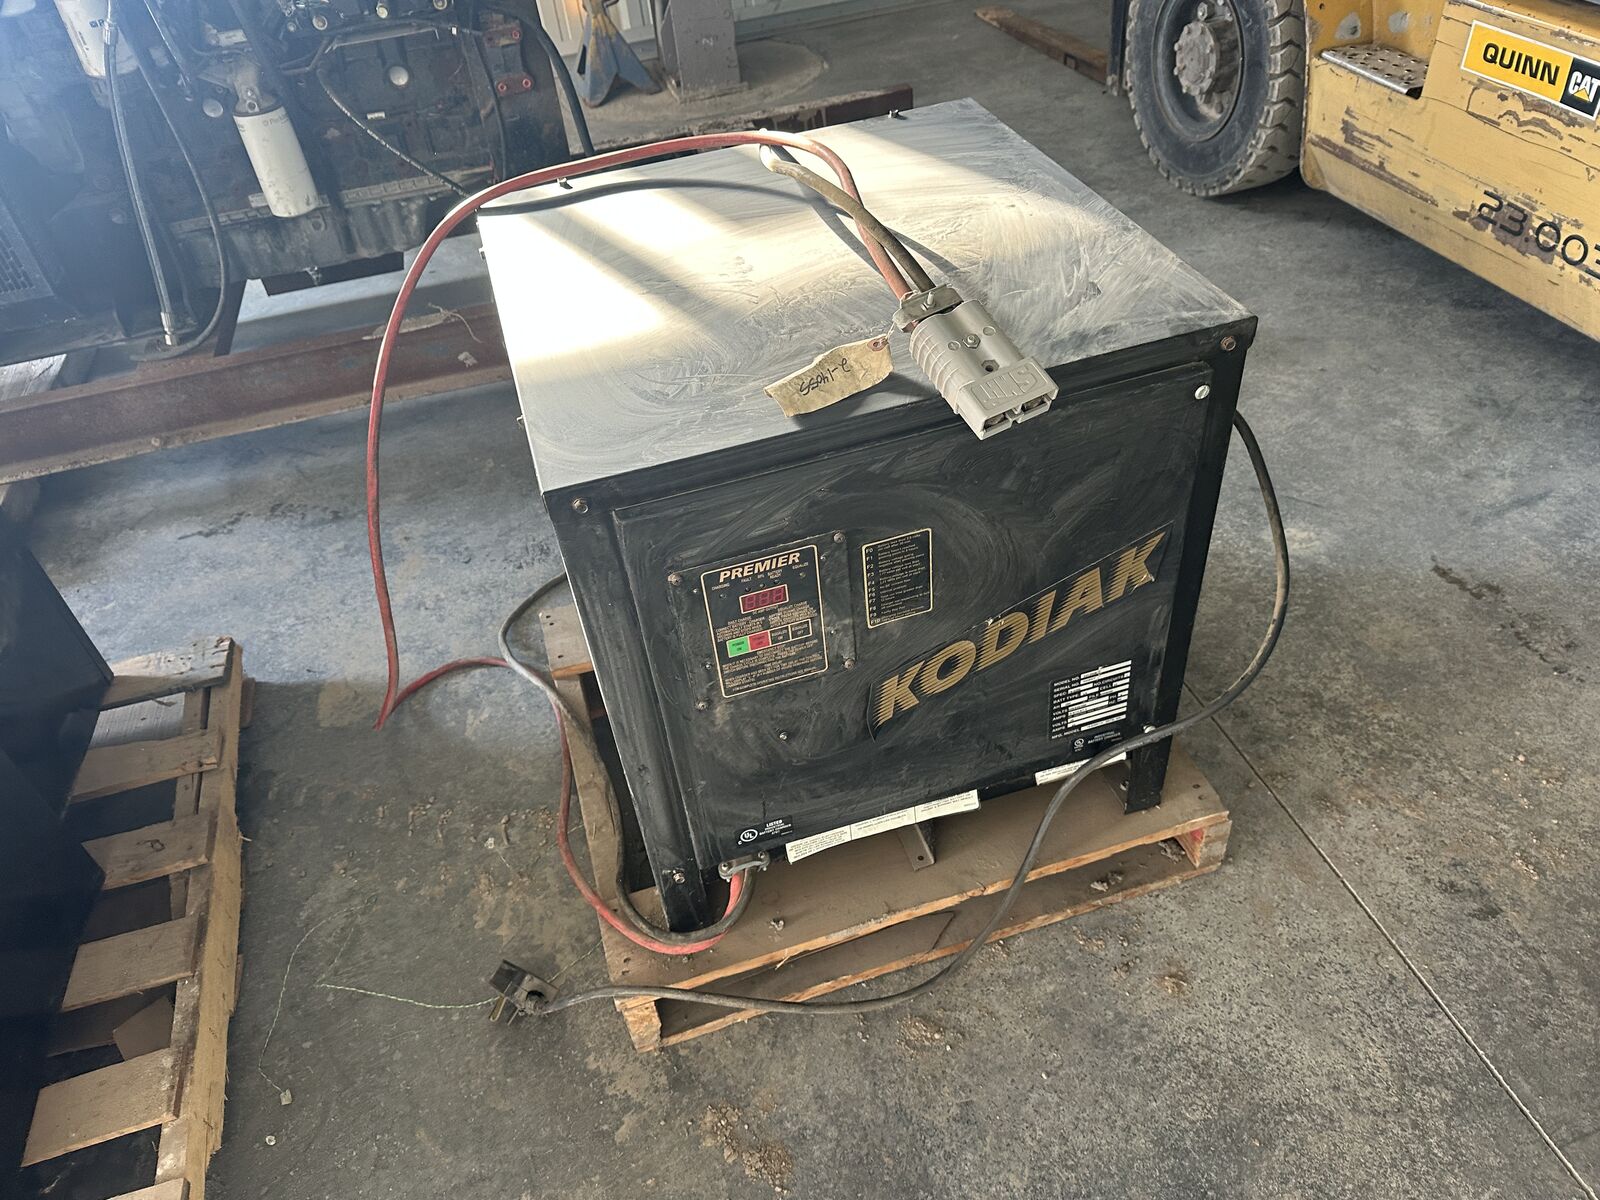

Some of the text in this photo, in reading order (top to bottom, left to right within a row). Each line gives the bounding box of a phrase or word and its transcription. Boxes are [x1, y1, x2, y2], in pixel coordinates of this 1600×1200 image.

[1482, 43, 1560, 86] QUINN
[1568, 70, 1600, 103] CAT
[1477, 189, 1600, 280] 23.00
[719, 552, 801, 583] PREMIER
[872, 531, 1167, 730] KODIAK
[766, 819, 783, 828] LISTED
